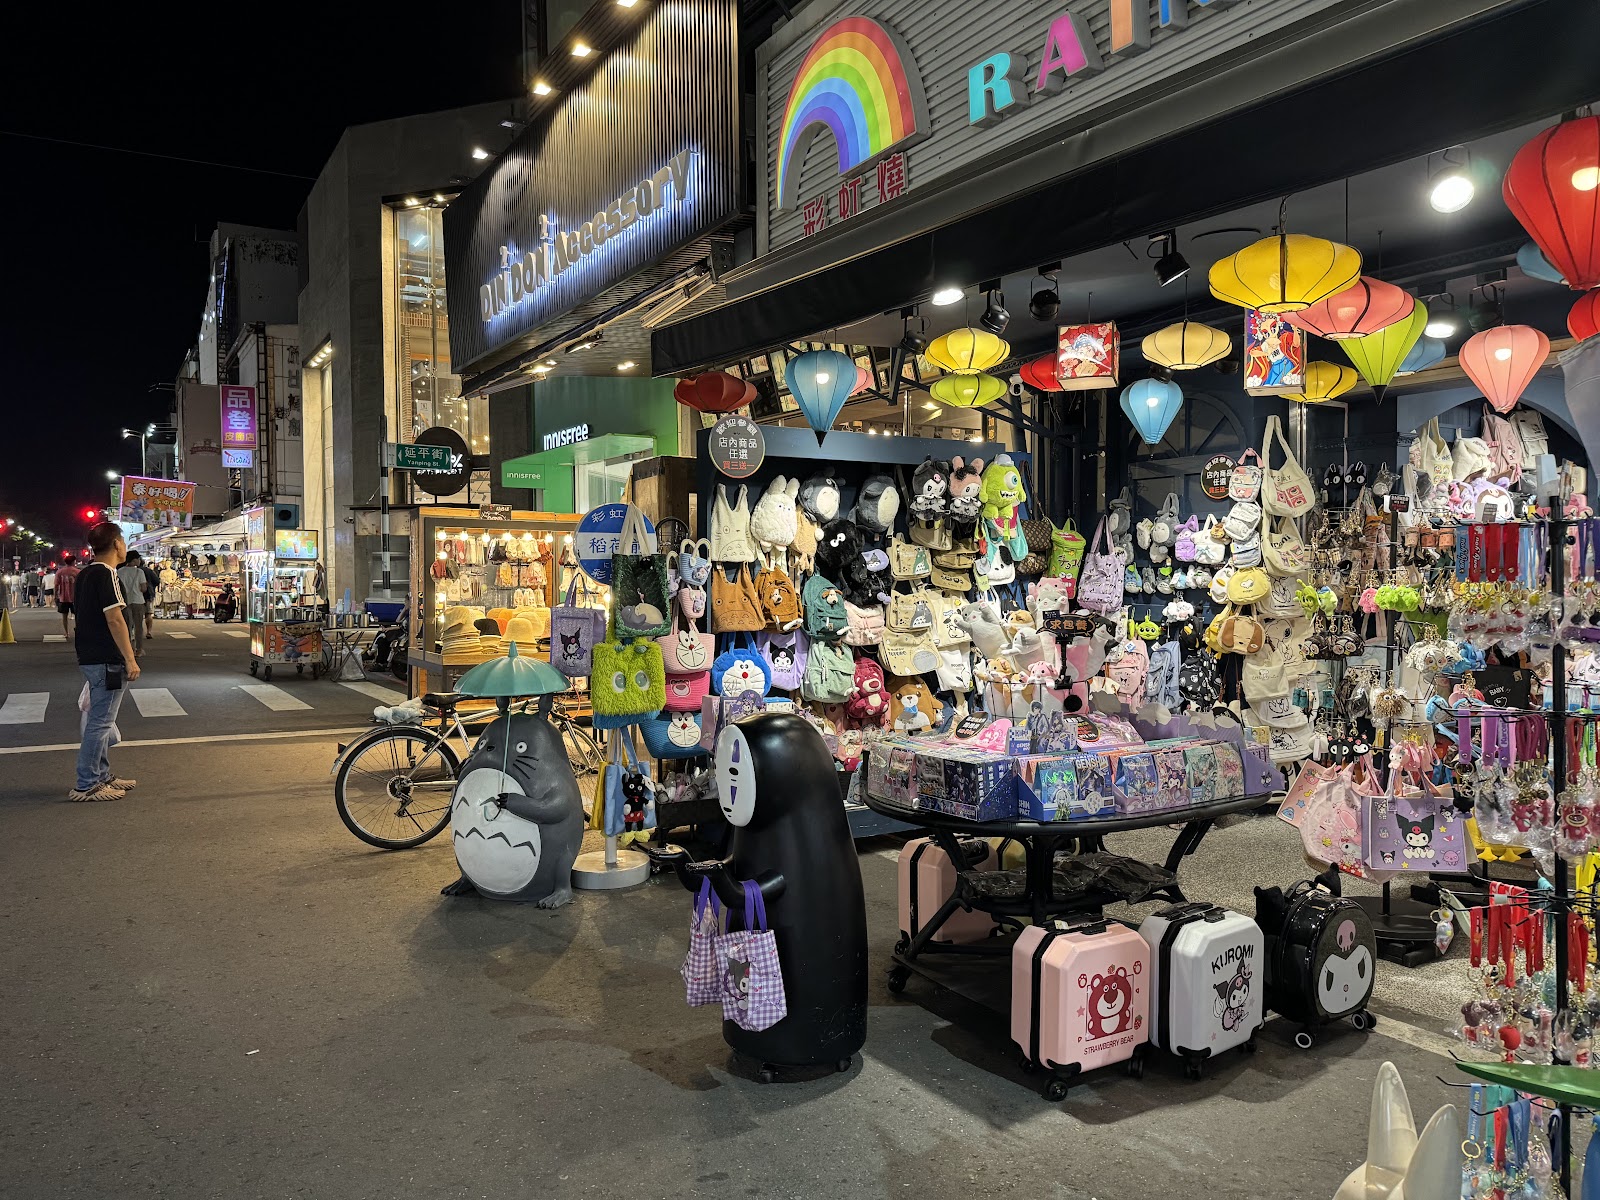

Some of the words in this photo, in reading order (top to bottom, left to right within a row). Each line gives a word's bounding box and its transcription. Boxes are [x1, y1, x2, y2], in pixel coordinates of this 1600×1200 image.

[803, 153, 906, 236] 彩虹燒
[404, 446, 443, 460] 延平街
[728, 448, 748, 460] 任選
[407, 459, 431, 467] Yanping
[1050, 619, 1088, 631] 求包養
[1489, 686, 1505, 696] BABY
[1211, 944, 1254, 975] KUROMI
[1083, 1039, 1120, 1056] STRAWBERRY
[1120, 1034, 1135, 1045] BEAR
